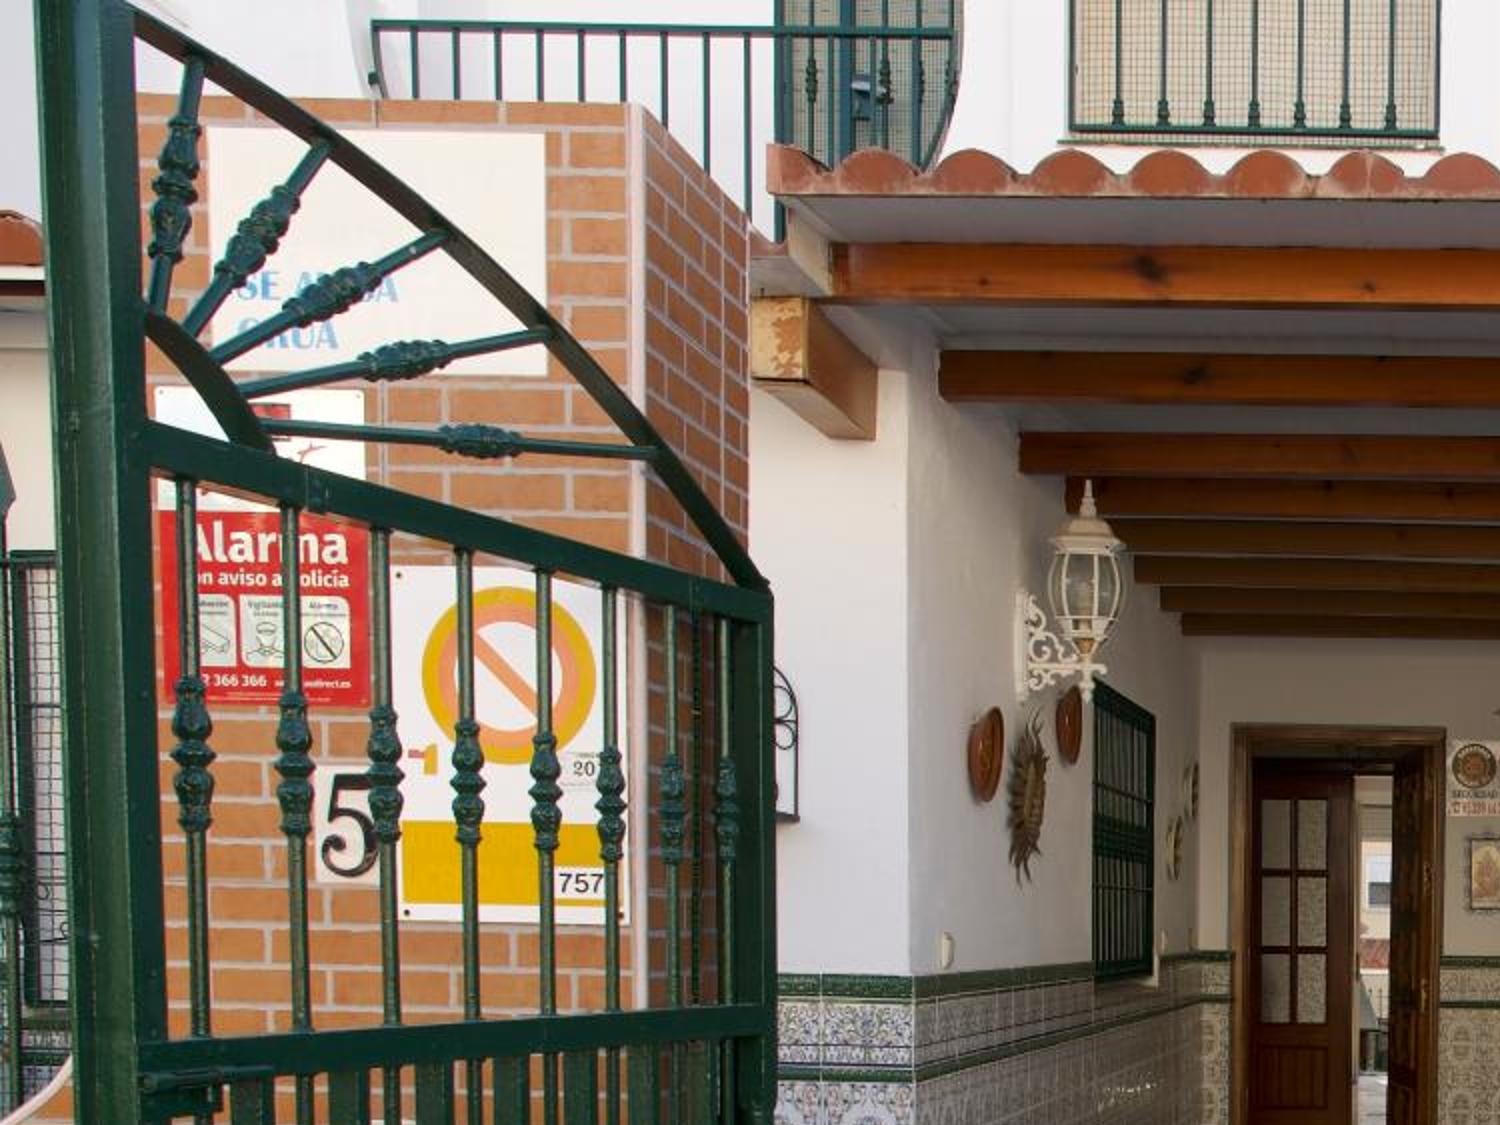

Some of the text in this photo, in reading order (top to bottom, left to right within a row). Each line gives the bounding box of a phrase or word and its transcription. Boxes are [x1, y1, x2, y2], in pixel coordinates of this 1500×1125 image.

[217, 568, 268, 587] aviso
[272, 572, 283, 587] a
[300, 569, 349, 587] olicía
[214, 673, 239, 687] 366
[242, 674, 267, 687] 366
[321, 773, 379, 878] 5
[558, 873, 605, 893] 757
